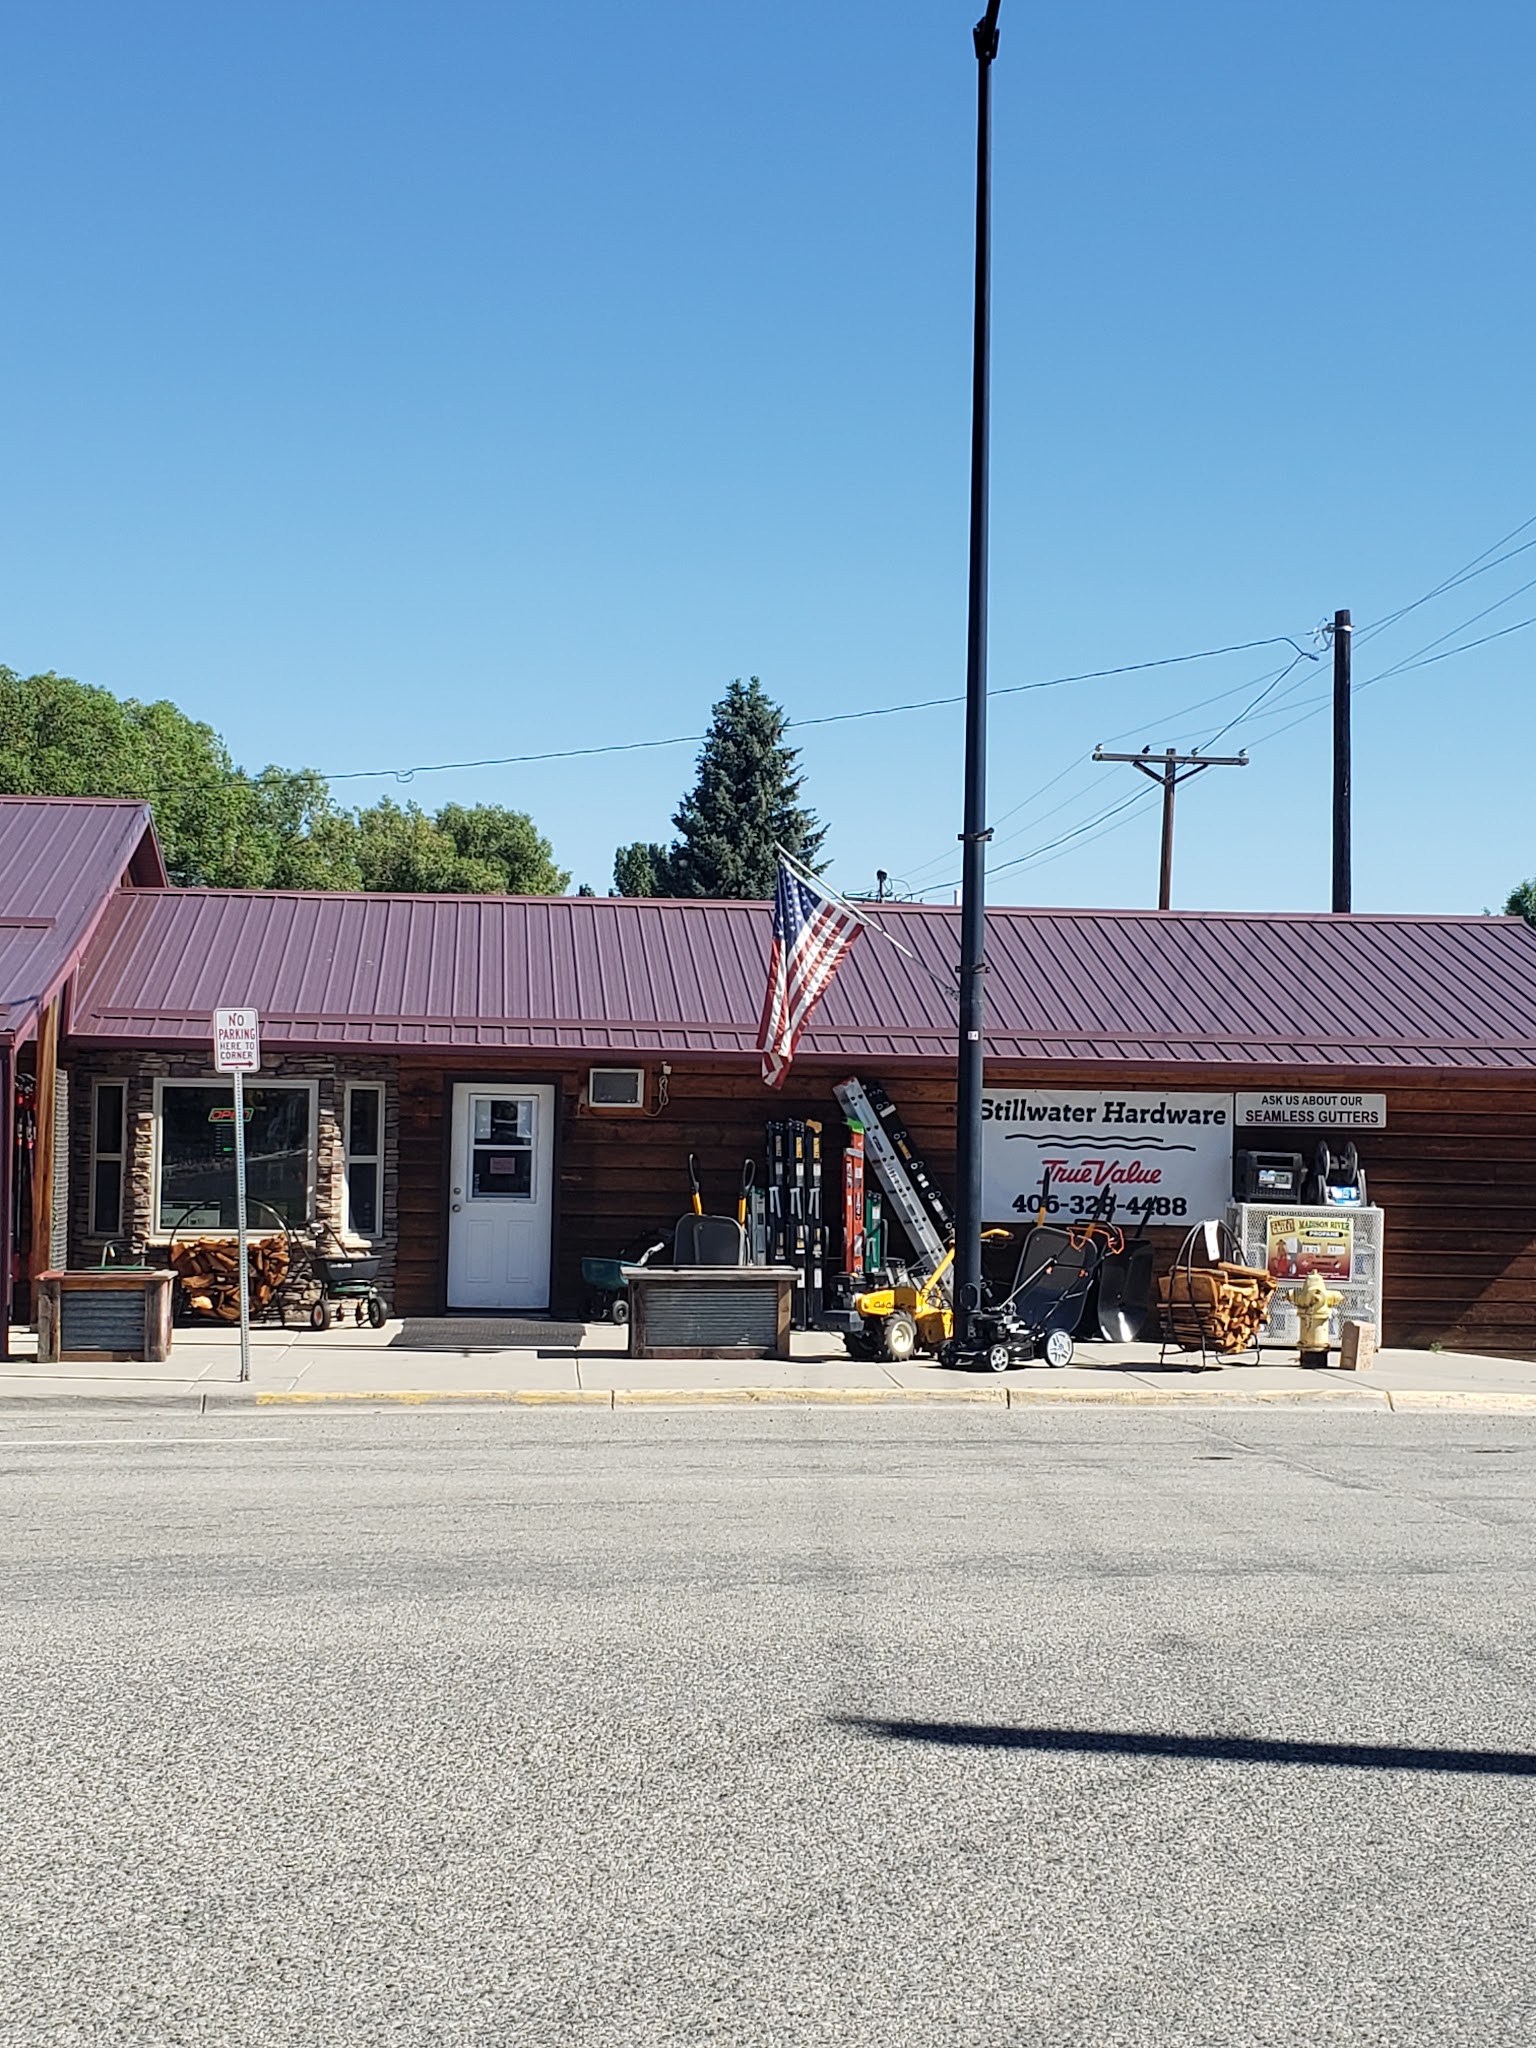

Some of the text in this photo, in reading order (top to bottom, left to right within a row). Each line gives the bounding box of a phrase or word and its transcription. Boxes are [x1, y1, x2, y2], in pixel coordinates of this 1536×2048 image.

[228, 1014, 245, 1026] NO
[218, 1028, 256, 1040] PARKING
[220, 1041, 255, 1050] HERE TO
[220, 1051, 253, 1060] CORNER
[1261, 1095, 1363, 1106] ASK US ABOUT OUR
[981, 1099, 1227, 1125] Stillwater Hardware
[1245, 1110, 1379, 1123] SEAMLESS GUTTERS
[1330, 1221, 1350, 1231] RIVER
